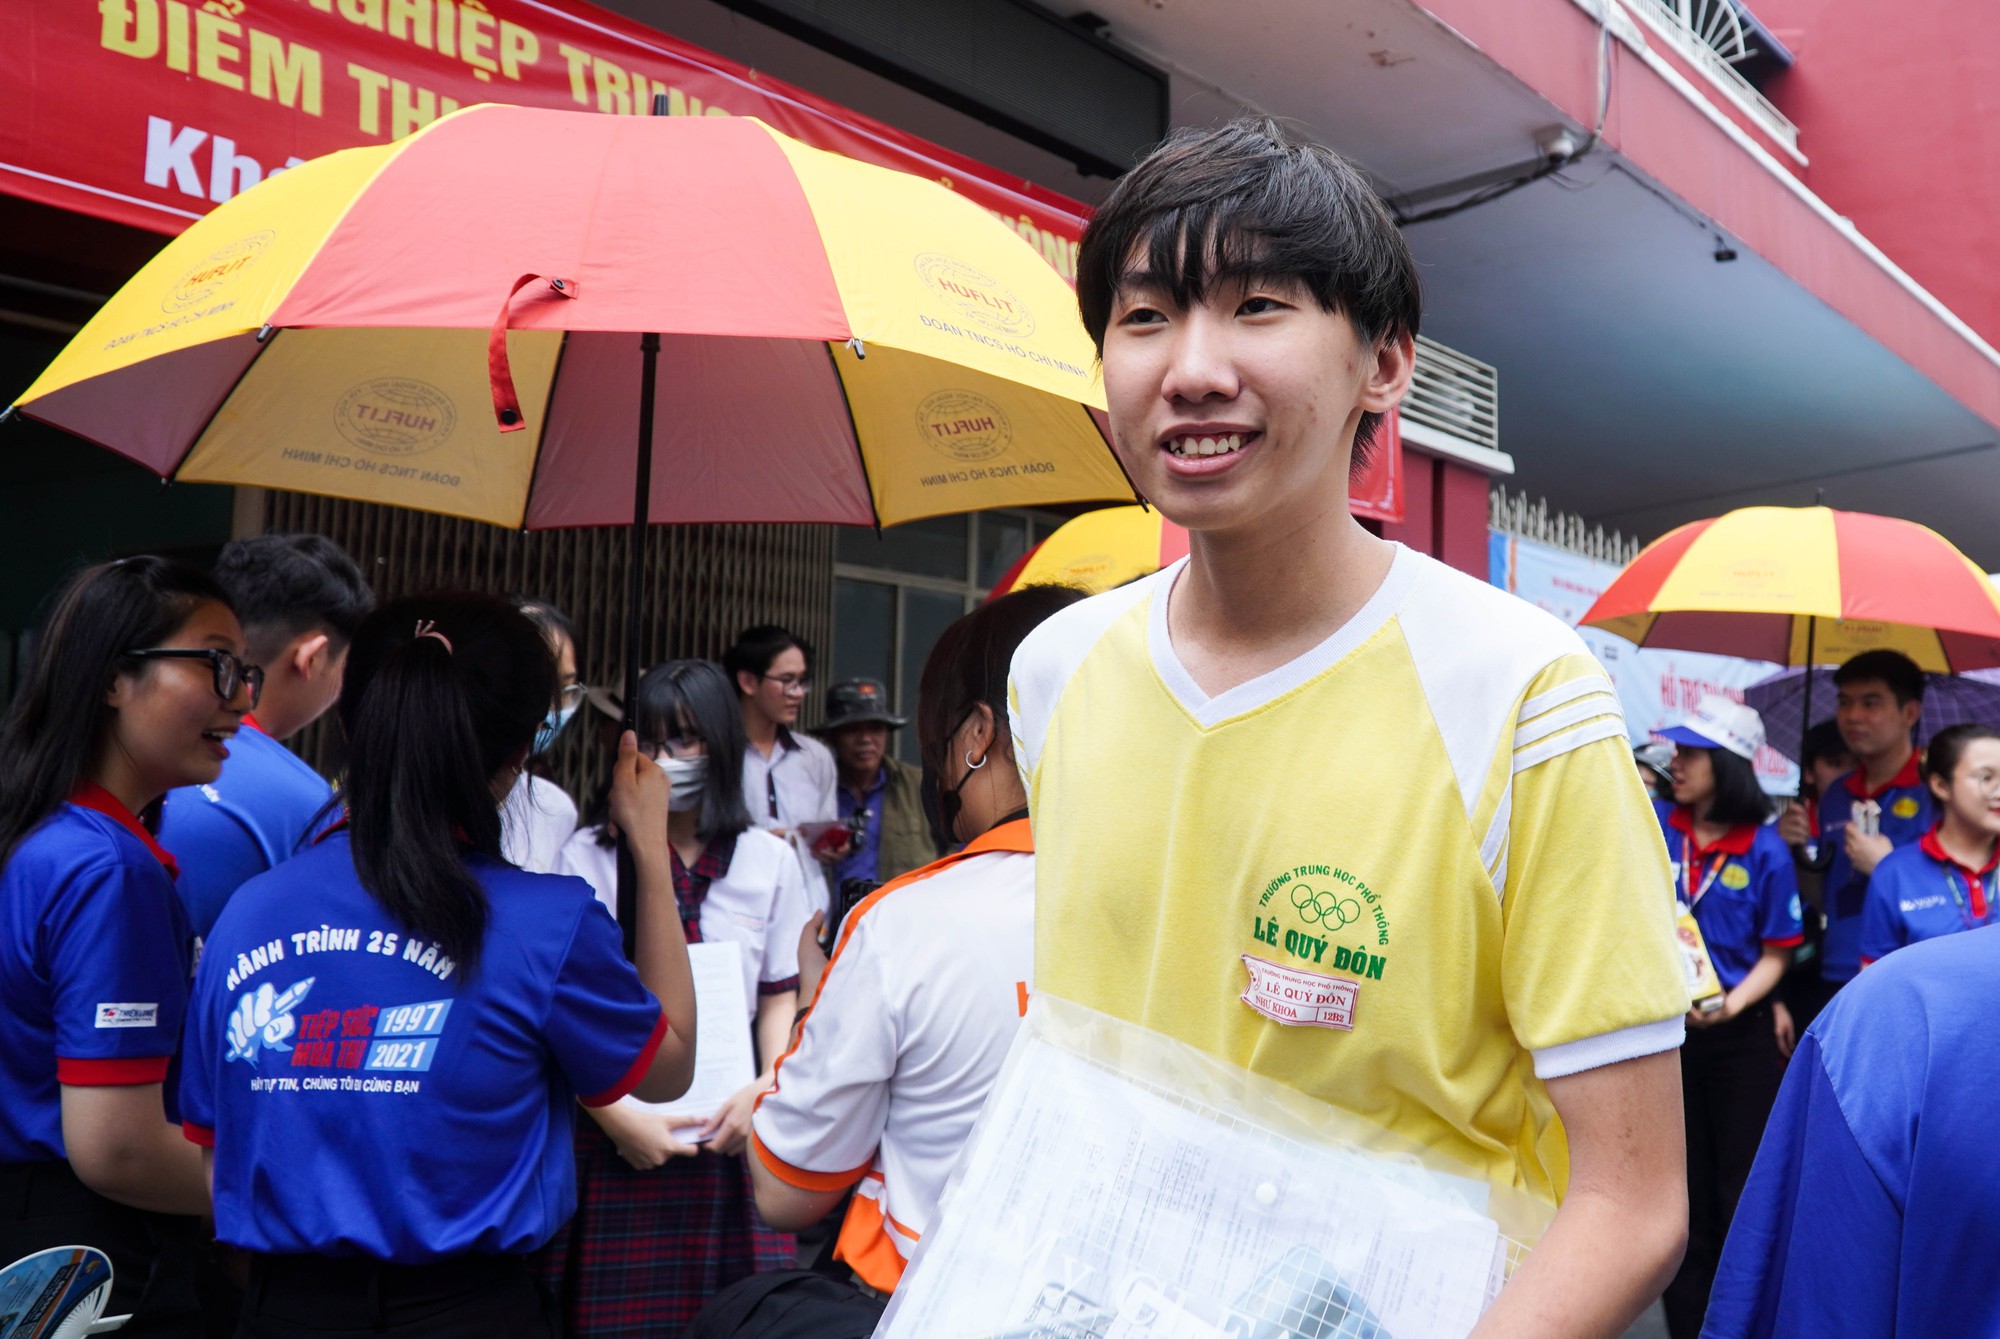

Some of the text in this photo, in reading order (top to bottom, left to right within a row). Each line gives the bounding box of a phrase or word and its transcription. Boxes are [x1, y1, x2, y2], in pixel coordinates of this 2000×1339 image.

[98, 0, 459, 141] ĐIỂM TH
[303, 0, 540, 82] GHIỆP
[559, 42, 732, 116] TRUN
[938, 277, 1014, 313] HUFLIT
[965, 329, 1003, 351] TNCS
[1053, 359, 1088, 378] MINH
[1258, 865, 1389, 946] TRƯỜNG TRUNG HỌC PHỔ THÔNG
[225, 924, 456, 991] HÀNH TRÌNH 25 NĂM
[1253, 916, 1387, 981] LÊ QUÝ ĐÔN
[1266, 981, 1346, 1007] LÊ QUÝ ĐÔN
[1282, 975, 1301, 985] TRUNG
[1332, 984, 1354, 993] THÔNG
[298, 1009, 341, 1039] TIẾP
[383, 1002, 444, 1034] 1997
[1272, 1000, 1298, 1019] KHOA
[1323, 1011, 1345, 1023] 12B2
[291, 1038, 368, 1069] MÙA THI
[371, 1041, 427, 1068] 2021
[278, 1077, 300, 1092] TIN,
[302, 1075, 338, 1091] CHÚNG
[363, 1076, 392, 1092] CÙNG
[394, 1080, 420, 1095] BẠN
